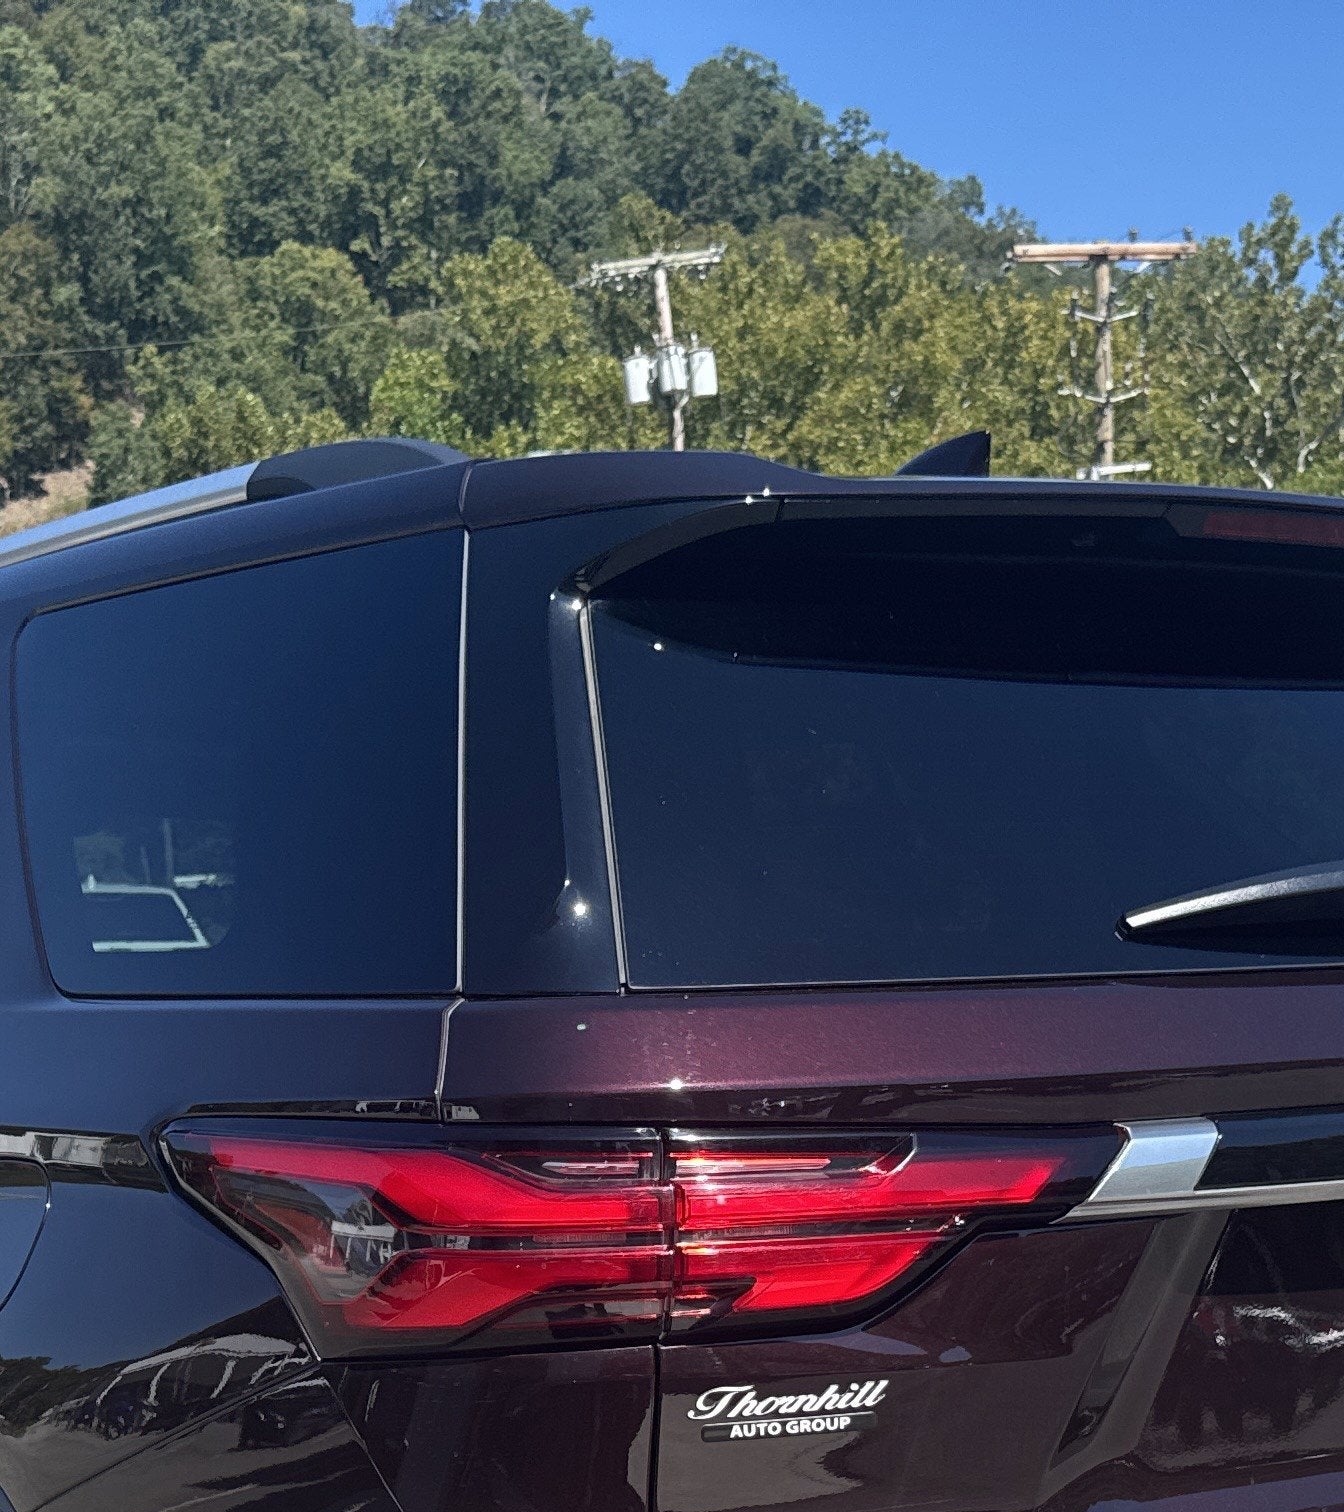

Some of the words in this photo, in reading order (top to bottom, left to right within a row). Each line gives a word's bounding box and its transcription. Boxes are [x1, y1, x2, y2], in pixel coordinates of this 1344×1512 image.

[687, 1379, 890, 1420] Thornhill
[729, 1421, 782, 1439] AUTO
[785, 1416, 851, 1434] GROUP
